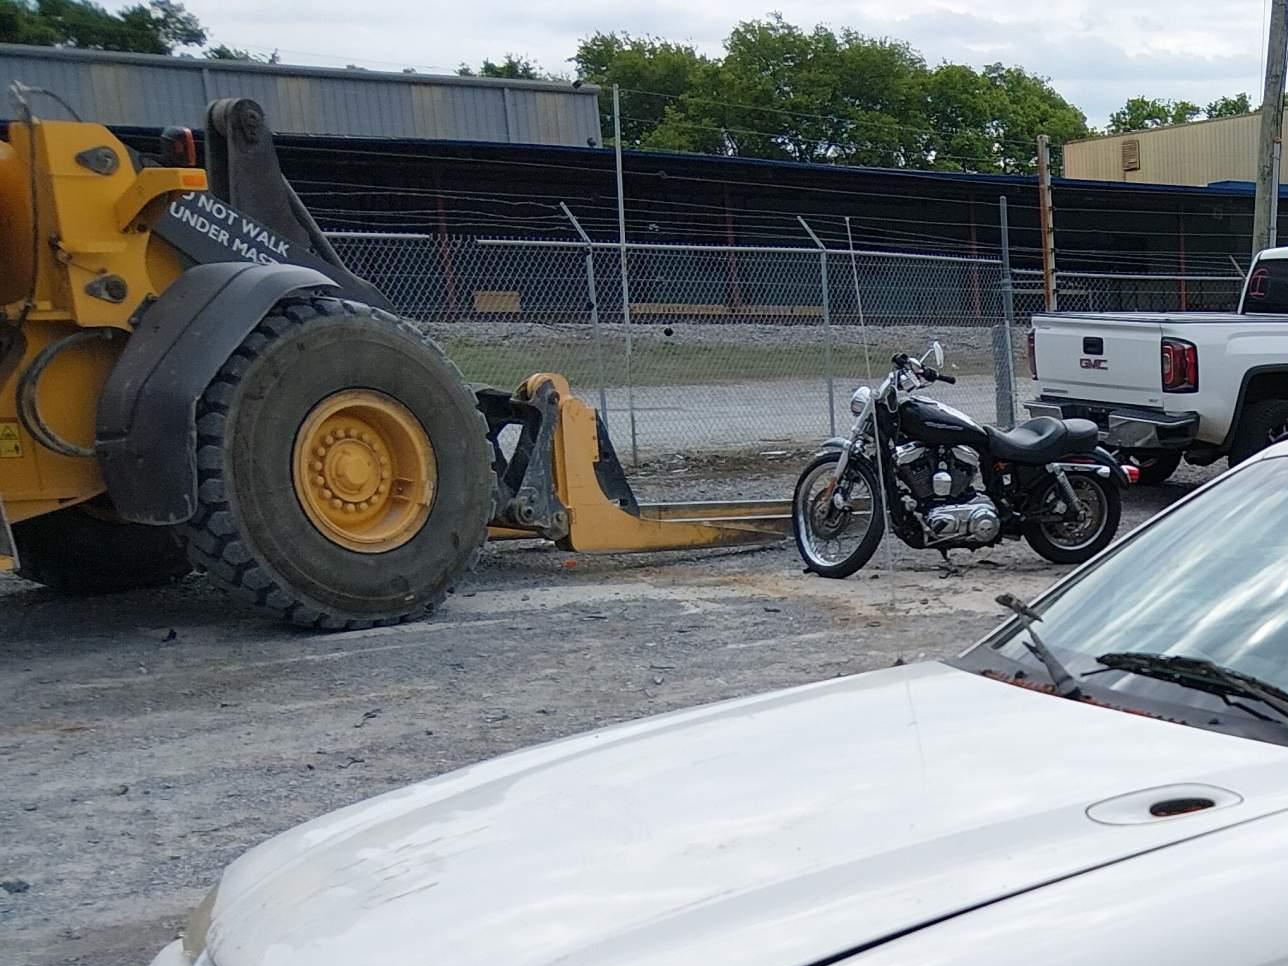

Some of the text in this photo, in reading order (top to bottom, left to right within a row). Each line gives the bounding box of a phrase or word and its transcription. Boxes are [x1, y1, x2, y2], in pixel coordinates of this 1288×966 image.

[169, 201, 230, 246] UNDER
[198, 195, 290, 258] NOT WALK
[1080, 358, 1108, 370] GMC
